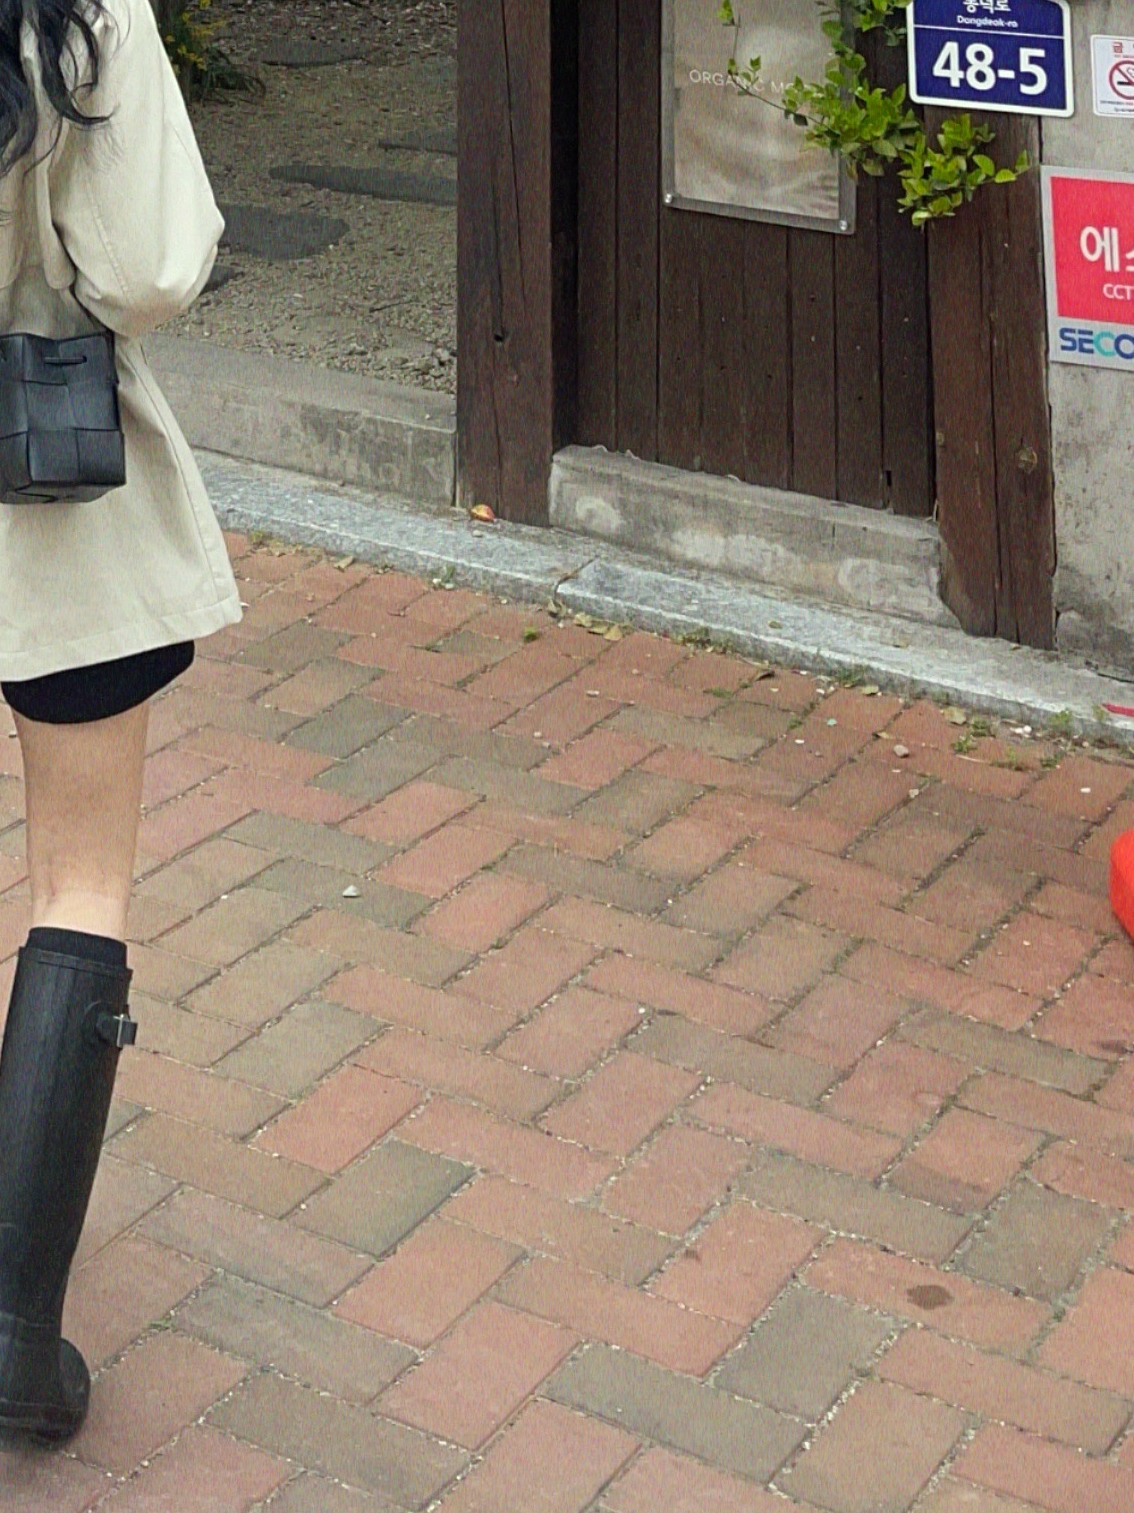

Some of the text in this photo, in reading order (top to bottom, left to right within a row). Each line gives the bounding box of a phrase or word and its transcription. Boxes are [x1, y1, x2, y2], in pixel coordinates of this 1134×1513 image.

[689, 69, 764, 92] ORGANC
[932, 41, 1047, 95] 48-5
[1103, 283, 1134, 301] CCT
[1059, 327, 1134, 359] SECO
